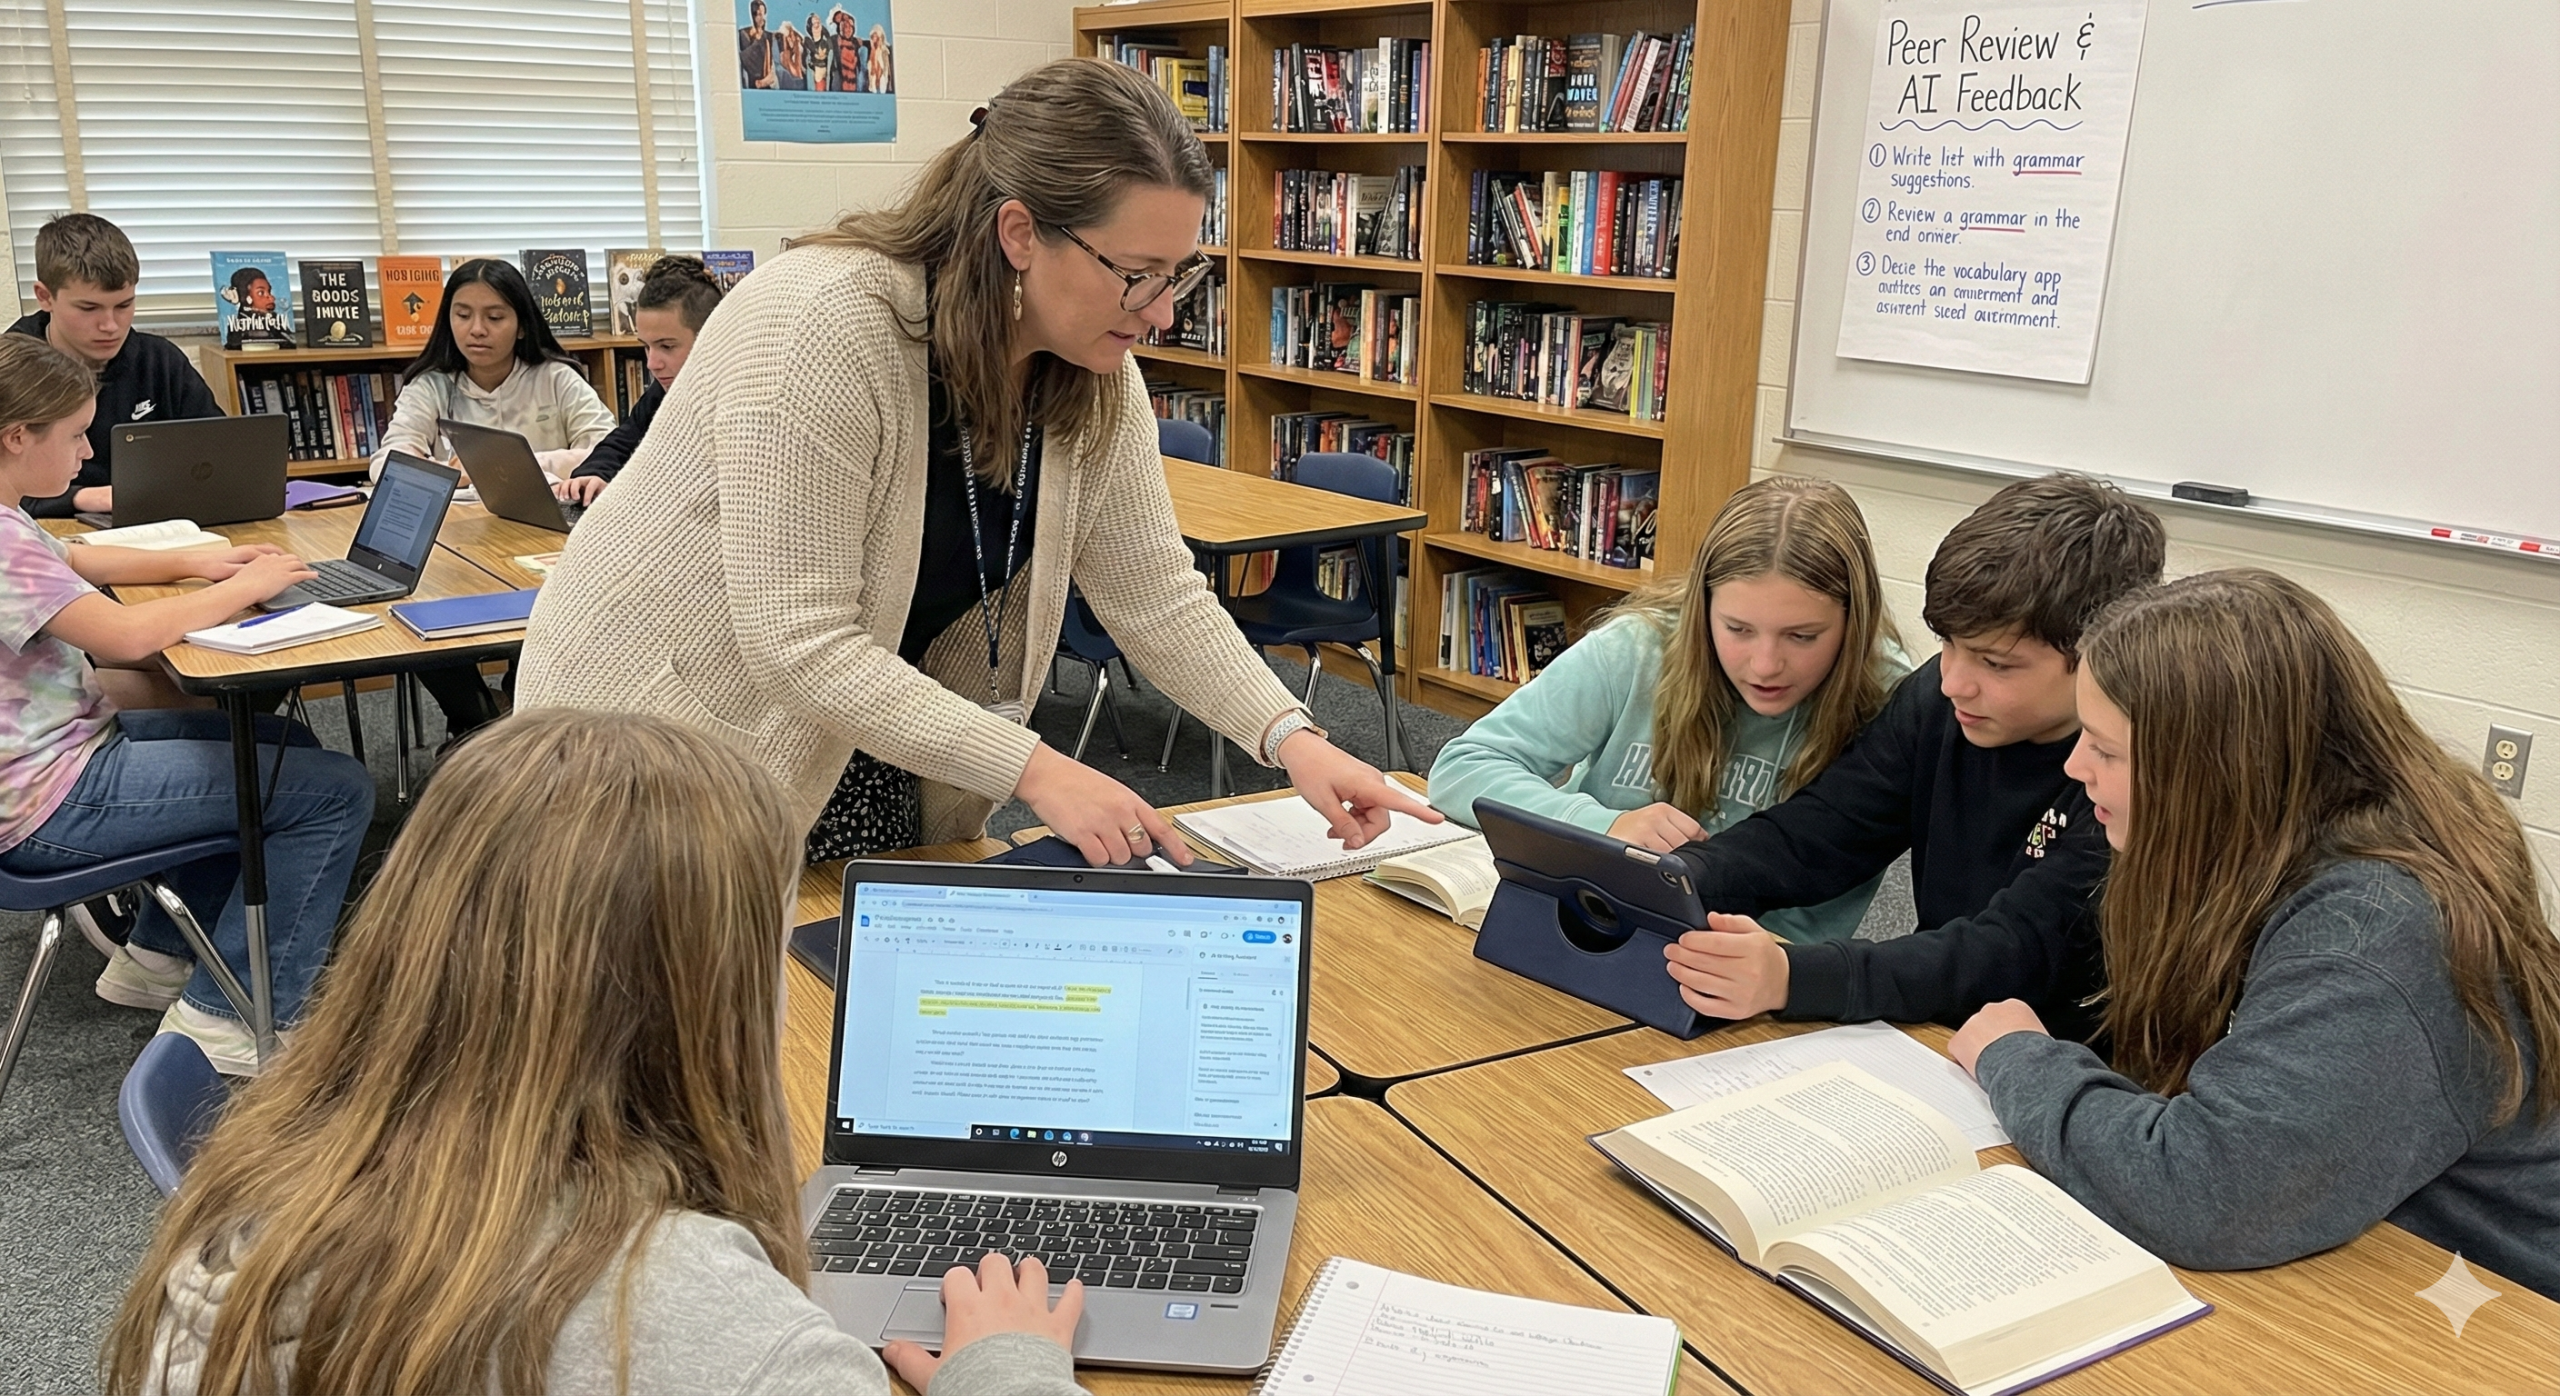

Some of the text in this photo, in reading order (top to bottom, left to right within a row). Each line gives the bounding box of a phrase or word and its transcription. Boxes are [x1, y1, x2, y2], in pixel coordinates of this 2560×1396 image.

[1887, 12, 2095, 66] Peer Review &
[1897, 72, 2082, 114] AI Feedback
[1893, 145, 1931, 167] Write
[1973, 147, 2005, 167] with
[2012, 154, 2085, 176] grammar
[1891, 169, 1975, 194] suggestions.
[1887, 200, 1936, 222] Review
[1943, 211, 1953, 223] a
[1960, 212, 2027, 231] grammar
[2034, 212, 2048, 227] in
[2055, 208, 2081, 229] the
[1886, 225, 1910, 242] end
[319, 273, 347, 286] THE
[1924, 258, 1946, 276] the
[1953, 262, 2028, 290] vocabulary
[2034, 271, 2062, 292] app
[1929, 286, 1946, 297] an
[2031, 288, 2059, 306] and
